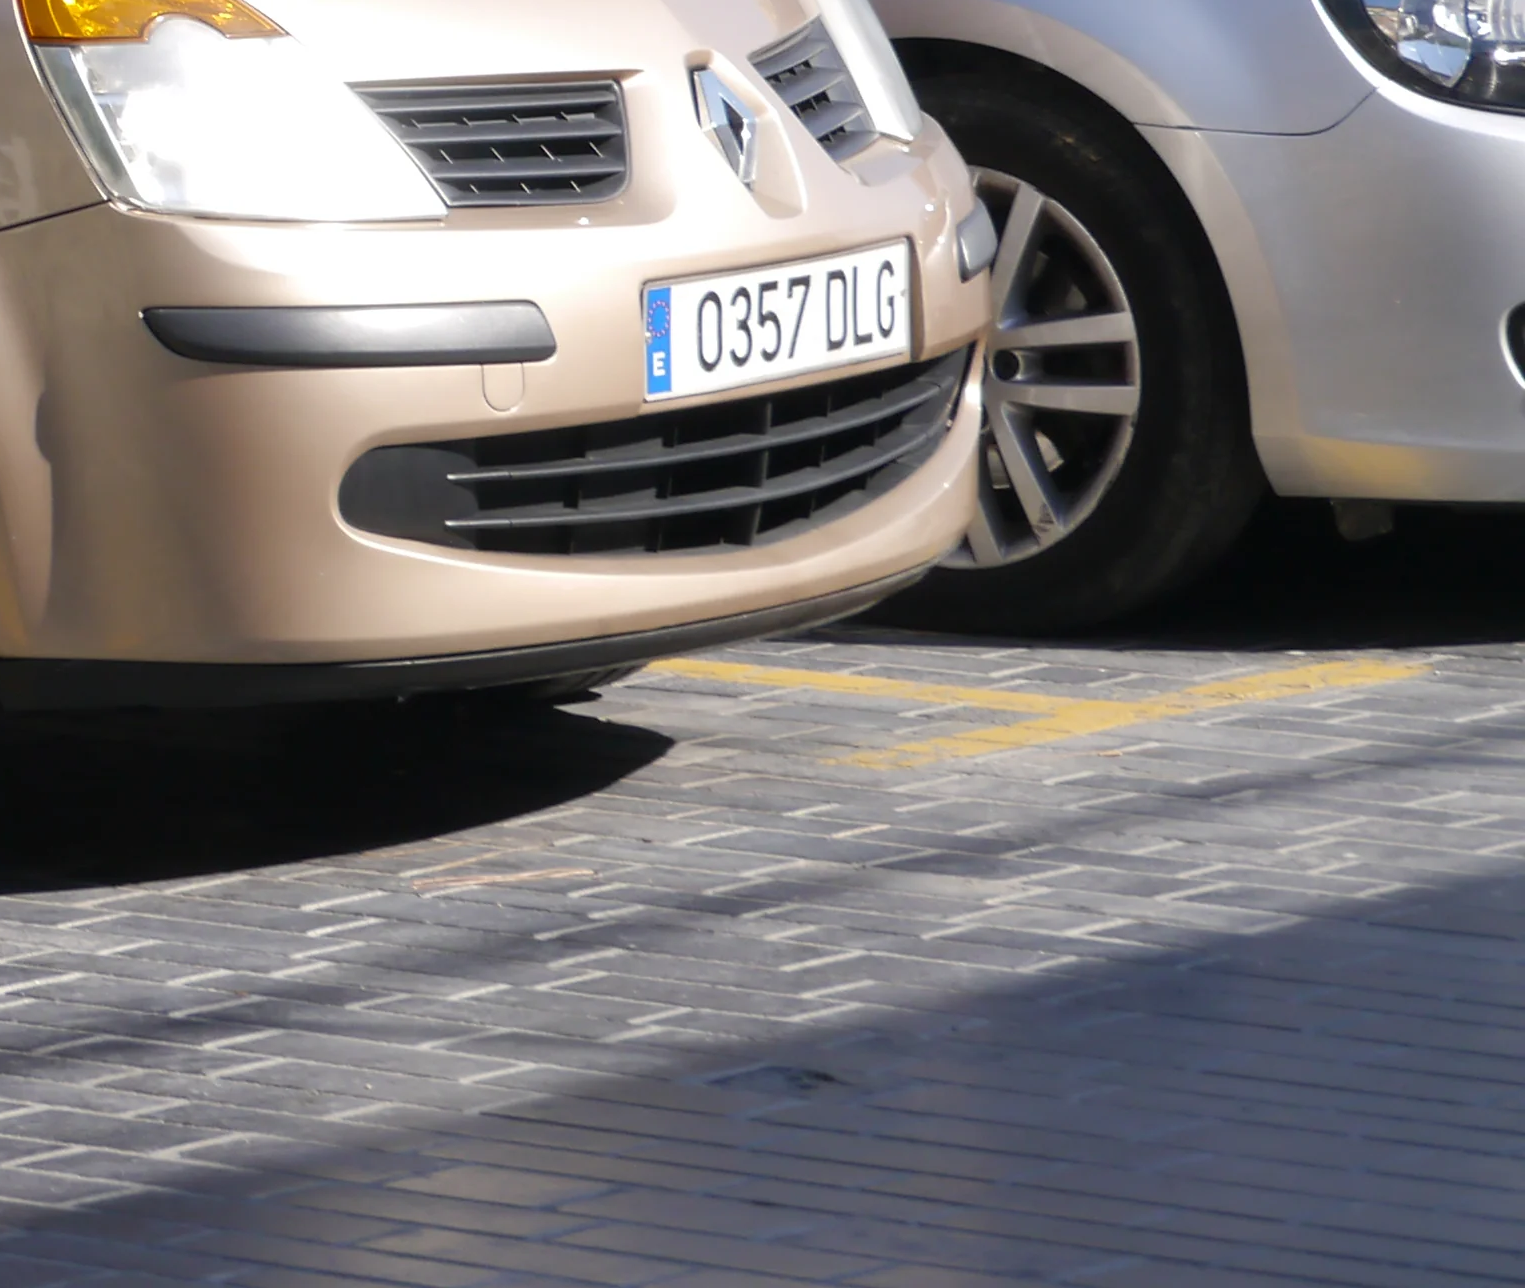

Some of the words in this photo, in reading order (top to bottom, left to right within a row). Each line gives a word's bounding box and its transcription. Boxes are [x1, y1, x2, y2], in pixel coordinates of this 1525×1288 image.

[696, 274, 811, 373] 0357
[826, 259, 896, 352] DLG
[652, 352, 666, 376] E
